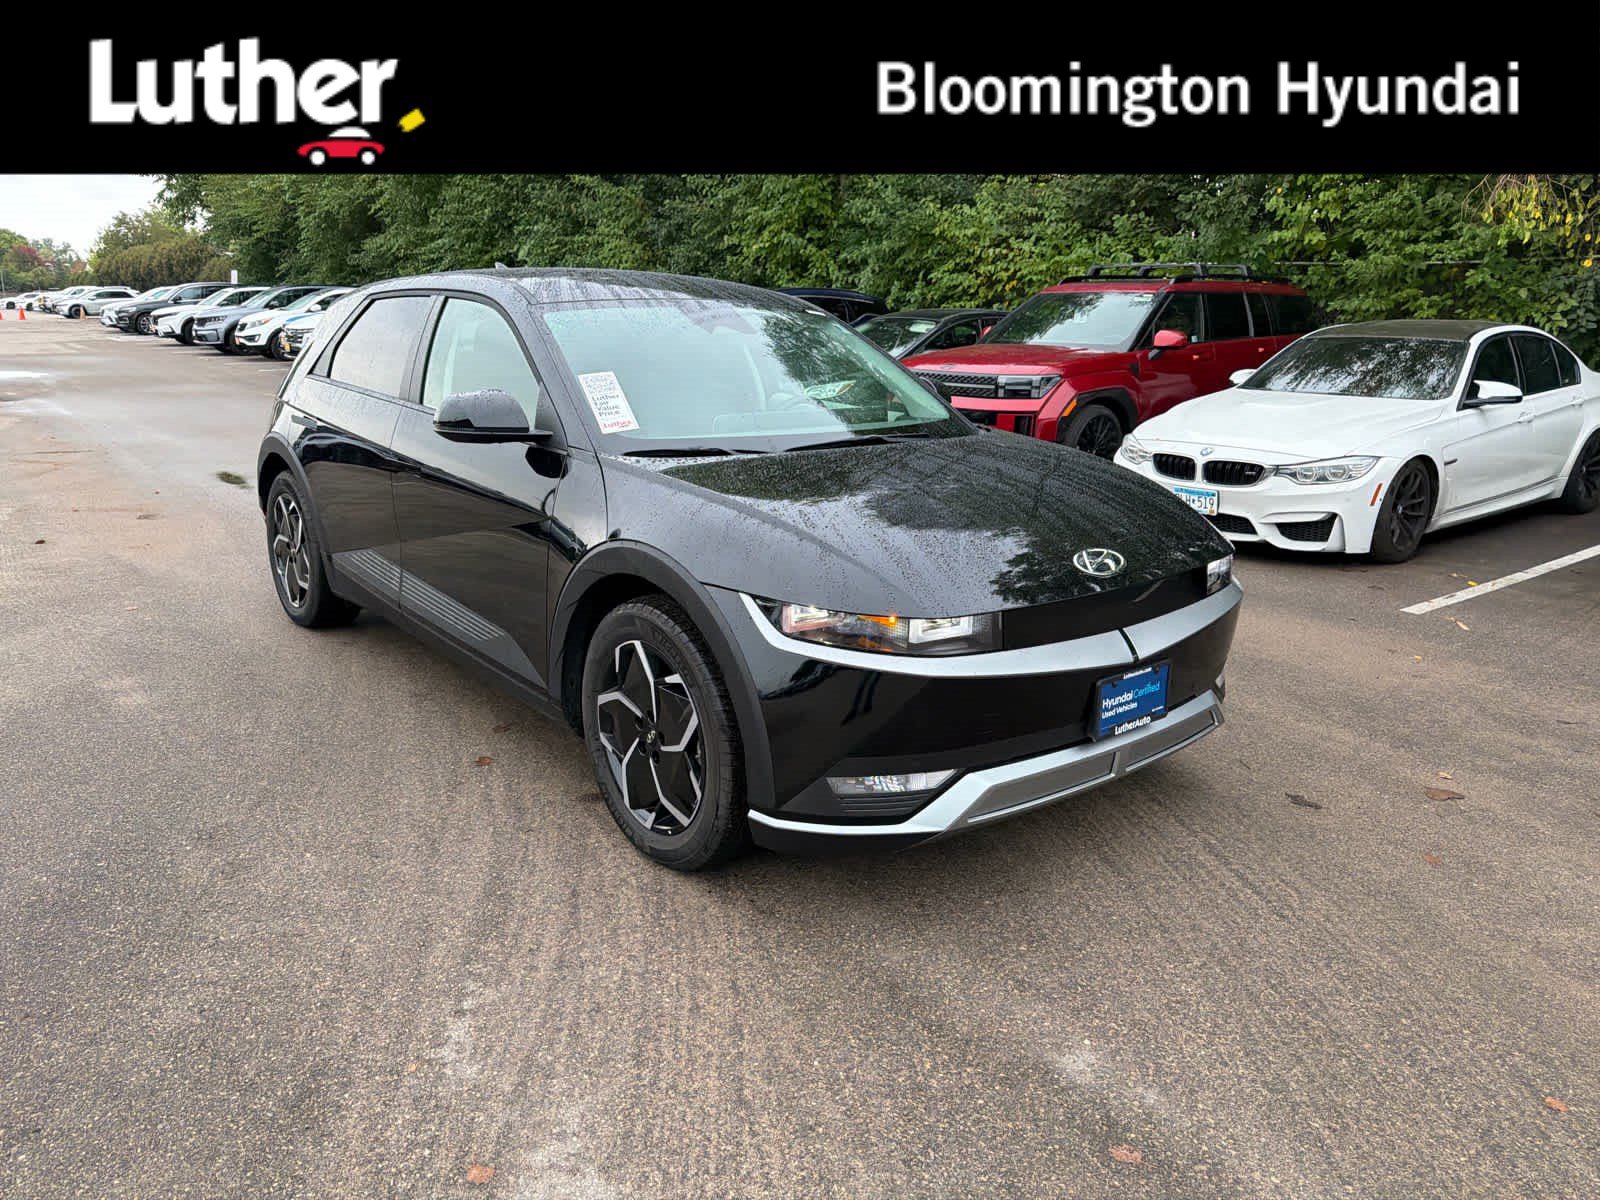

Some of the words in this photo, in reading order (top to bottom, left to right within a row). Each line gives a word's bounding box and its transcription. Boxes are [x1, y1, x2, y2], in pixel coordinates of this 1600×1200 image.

[1102, 690, 1133, 709] Hyundai
[1101, 709, 1116, 719] Used
[1116, 702, 1138, 714] Vehicles
[1114, 716, 1152, 736] LutherAuto
